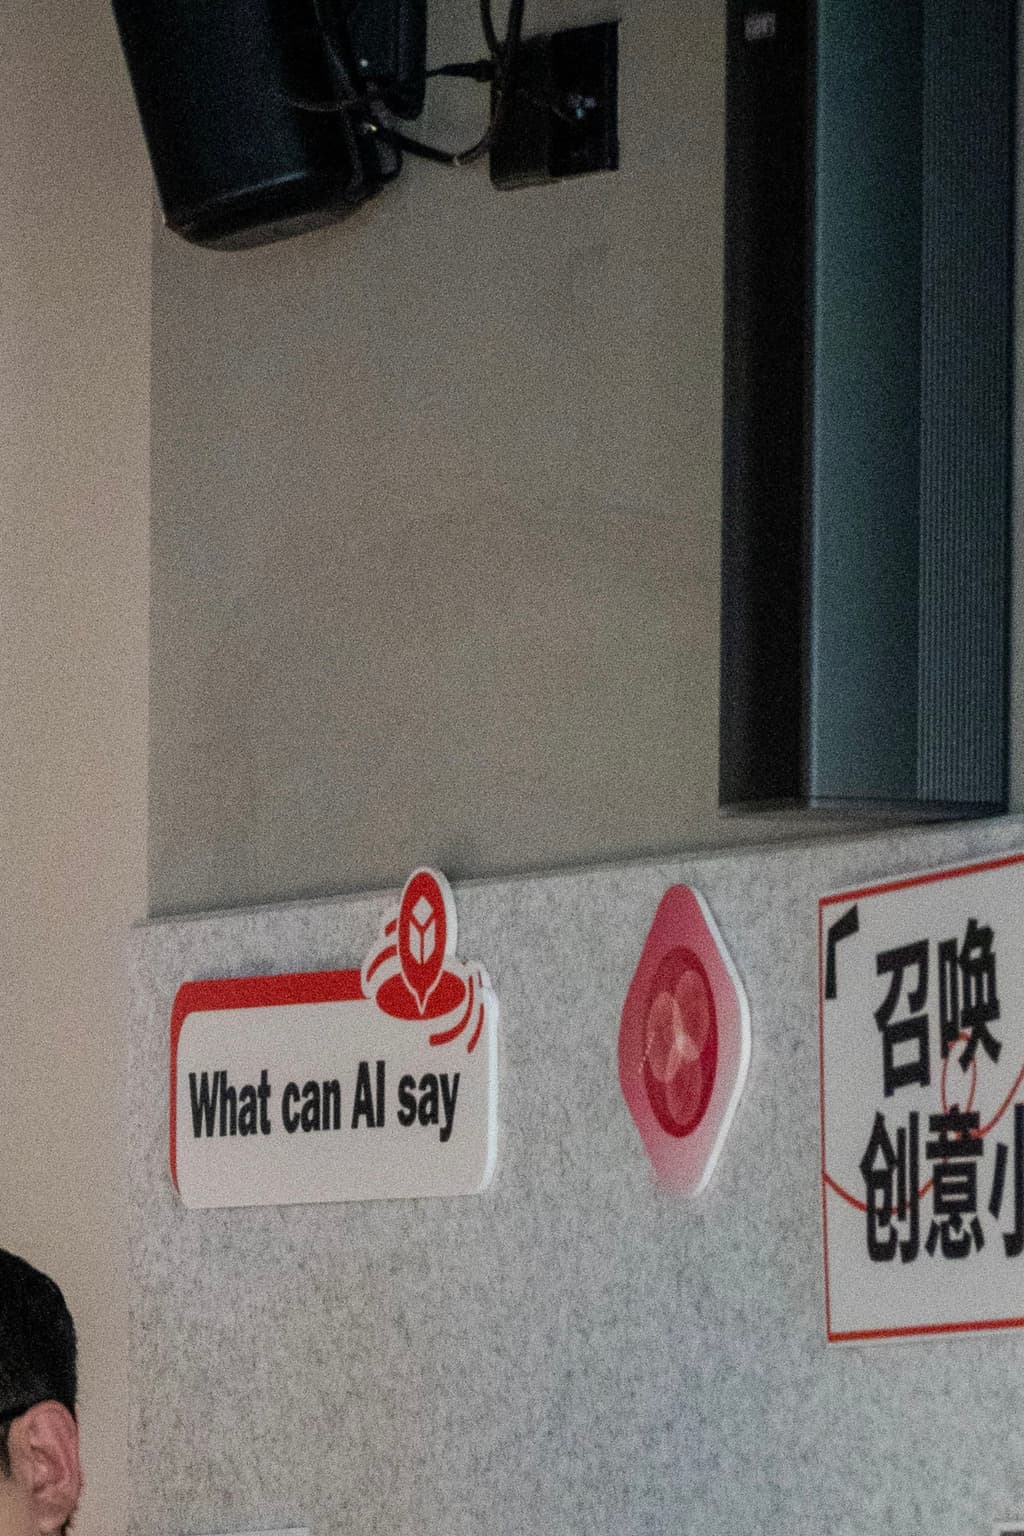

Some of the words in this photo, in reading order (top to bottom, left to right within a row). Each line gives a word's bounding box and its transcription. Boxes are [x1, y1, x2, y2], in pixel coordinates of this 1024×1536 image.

[188, 1069, 271, 1138] What
[281, 1078, 341, 1134] can
[351, 1060, 386, 1129] AI
[397, 1072, 461, 1142] say
